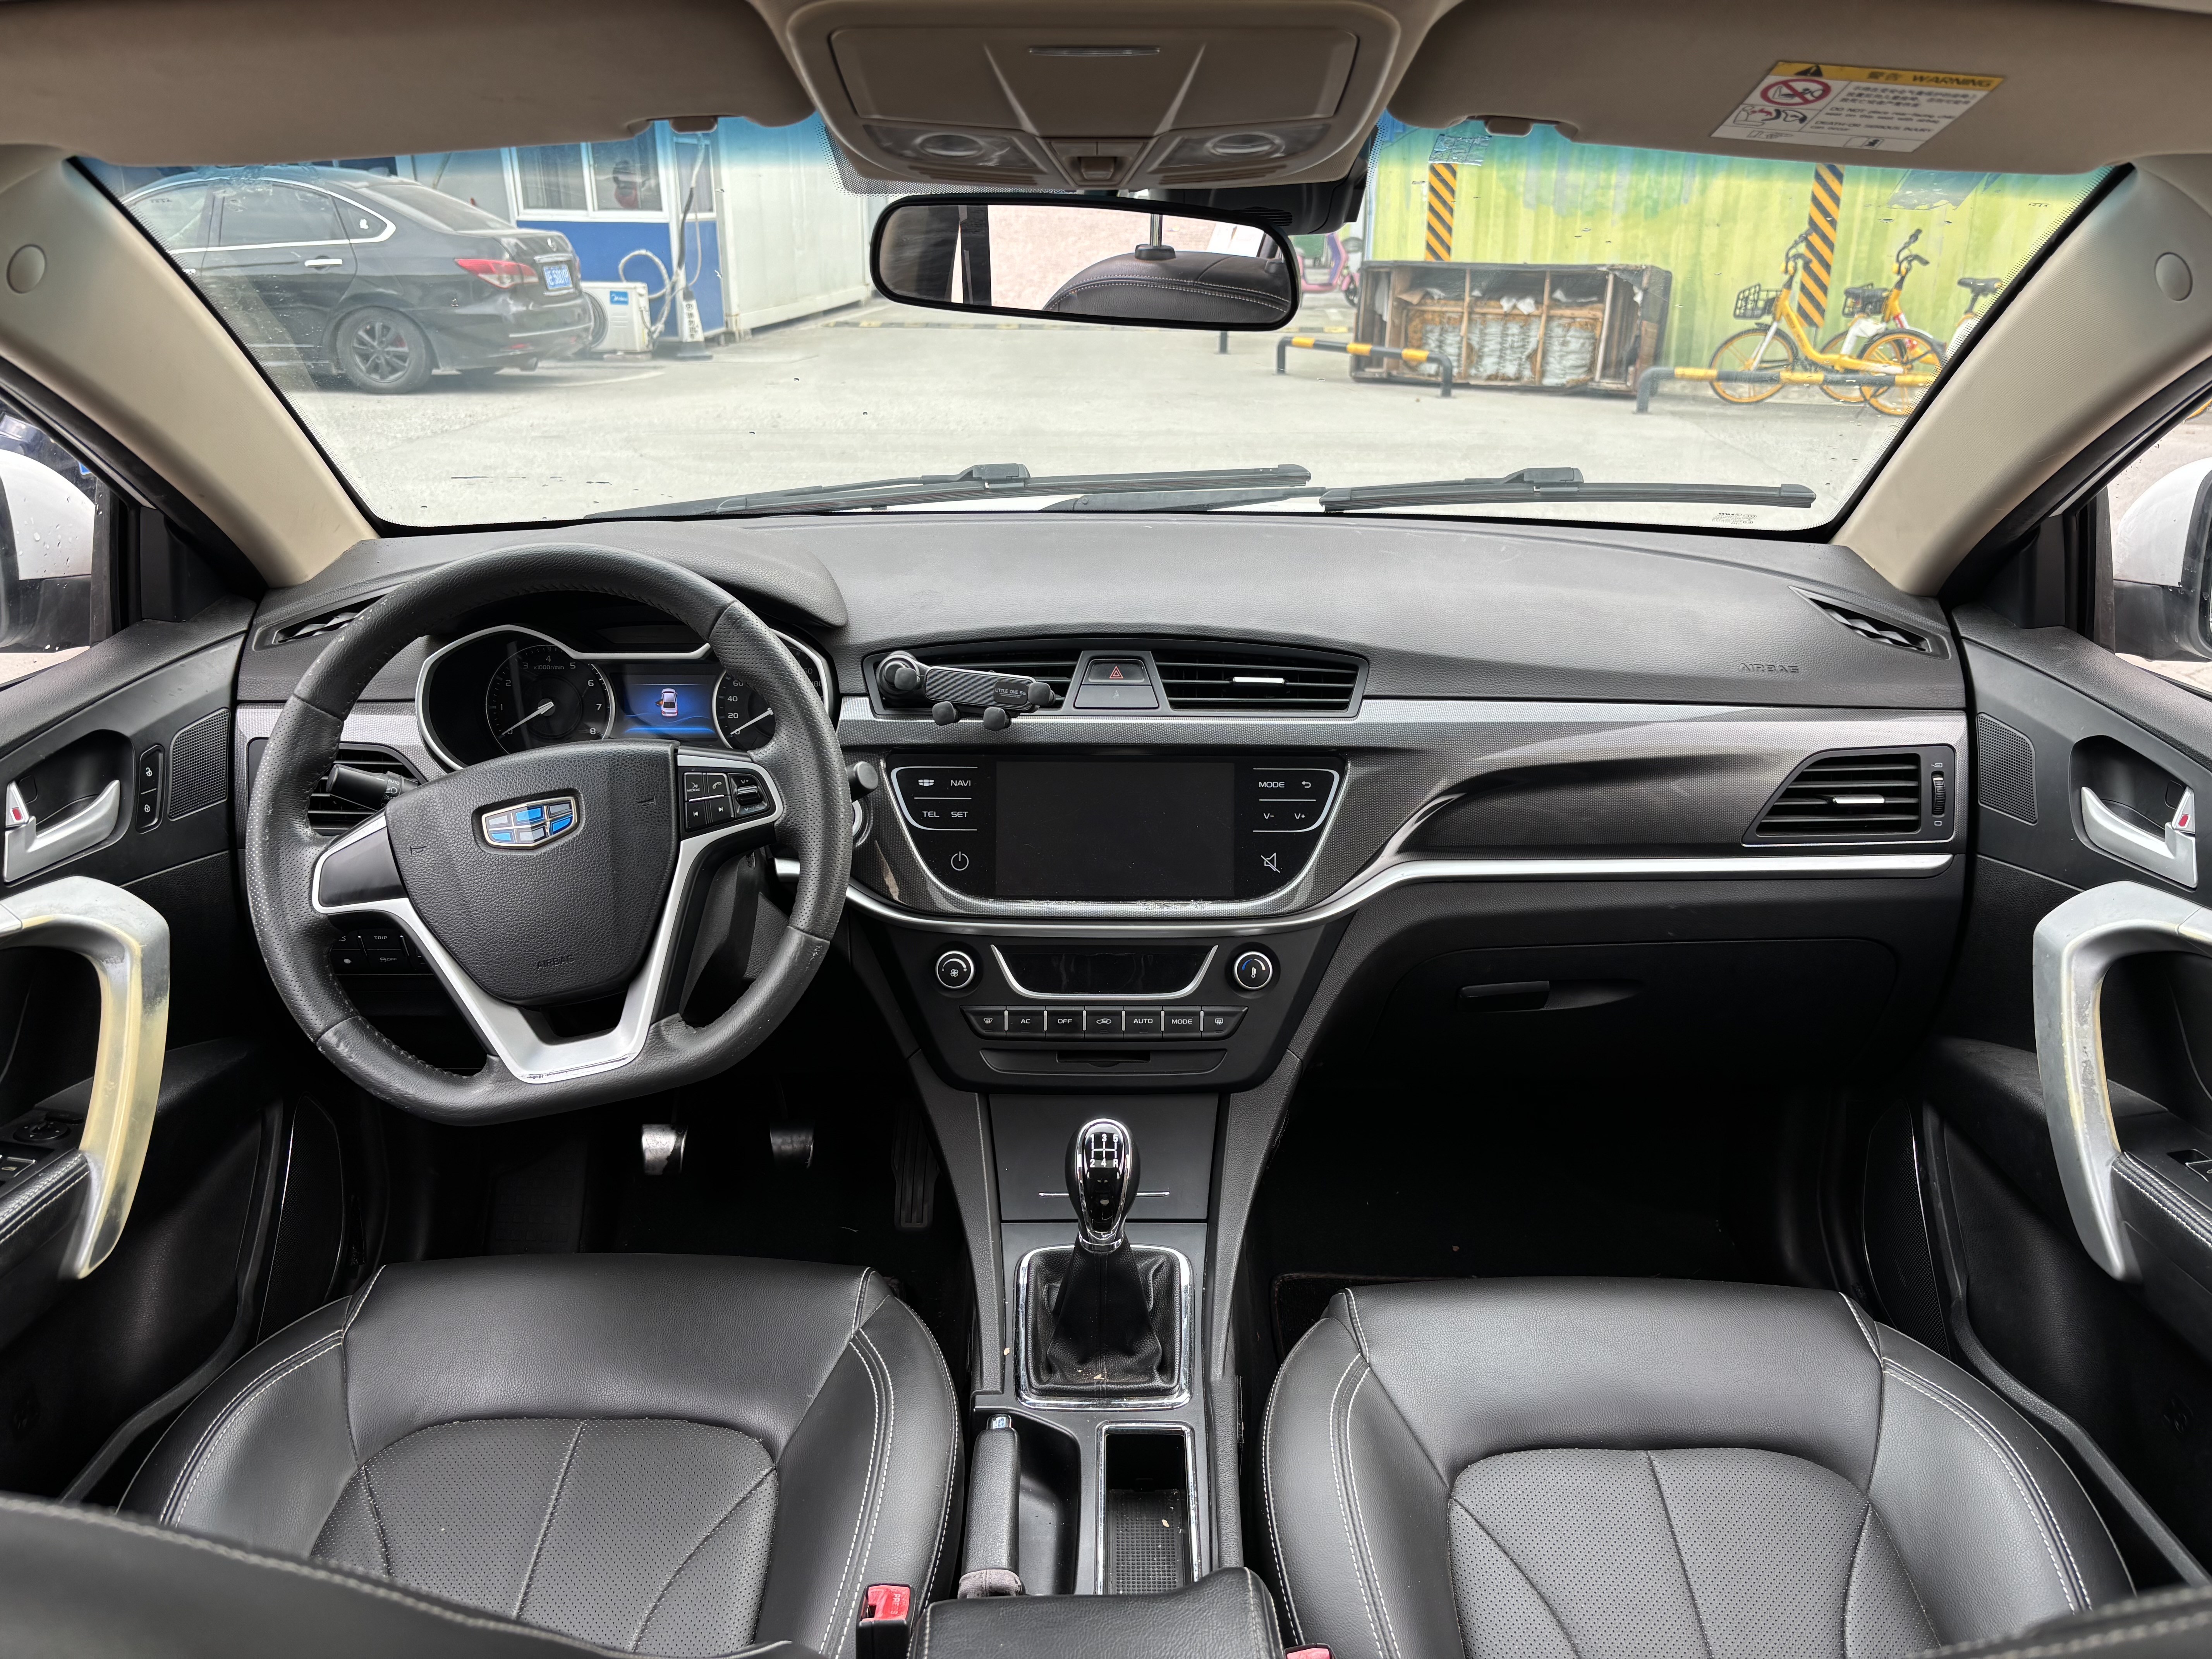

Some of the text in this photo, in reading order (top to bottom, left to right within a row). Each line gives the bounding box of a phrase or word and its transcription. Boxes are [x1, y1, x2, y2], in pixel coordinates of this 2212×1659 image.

[1913, 74, 1992, 88] WARNING
[1738, 663, 1799, 673] AIRBAG
[537, 955, 575, 969] AIRBAG
[1090, 1134, 1094, 1142] 1
[1101, 1133, 1107, 1142] 3
[1113, 1134, 1118, 1142] 5
[1090, 1159, 1095, 1168] 2
[1101, 1158, 1106, 1167] 4
[1113, 1159, 1119, 1168] R
